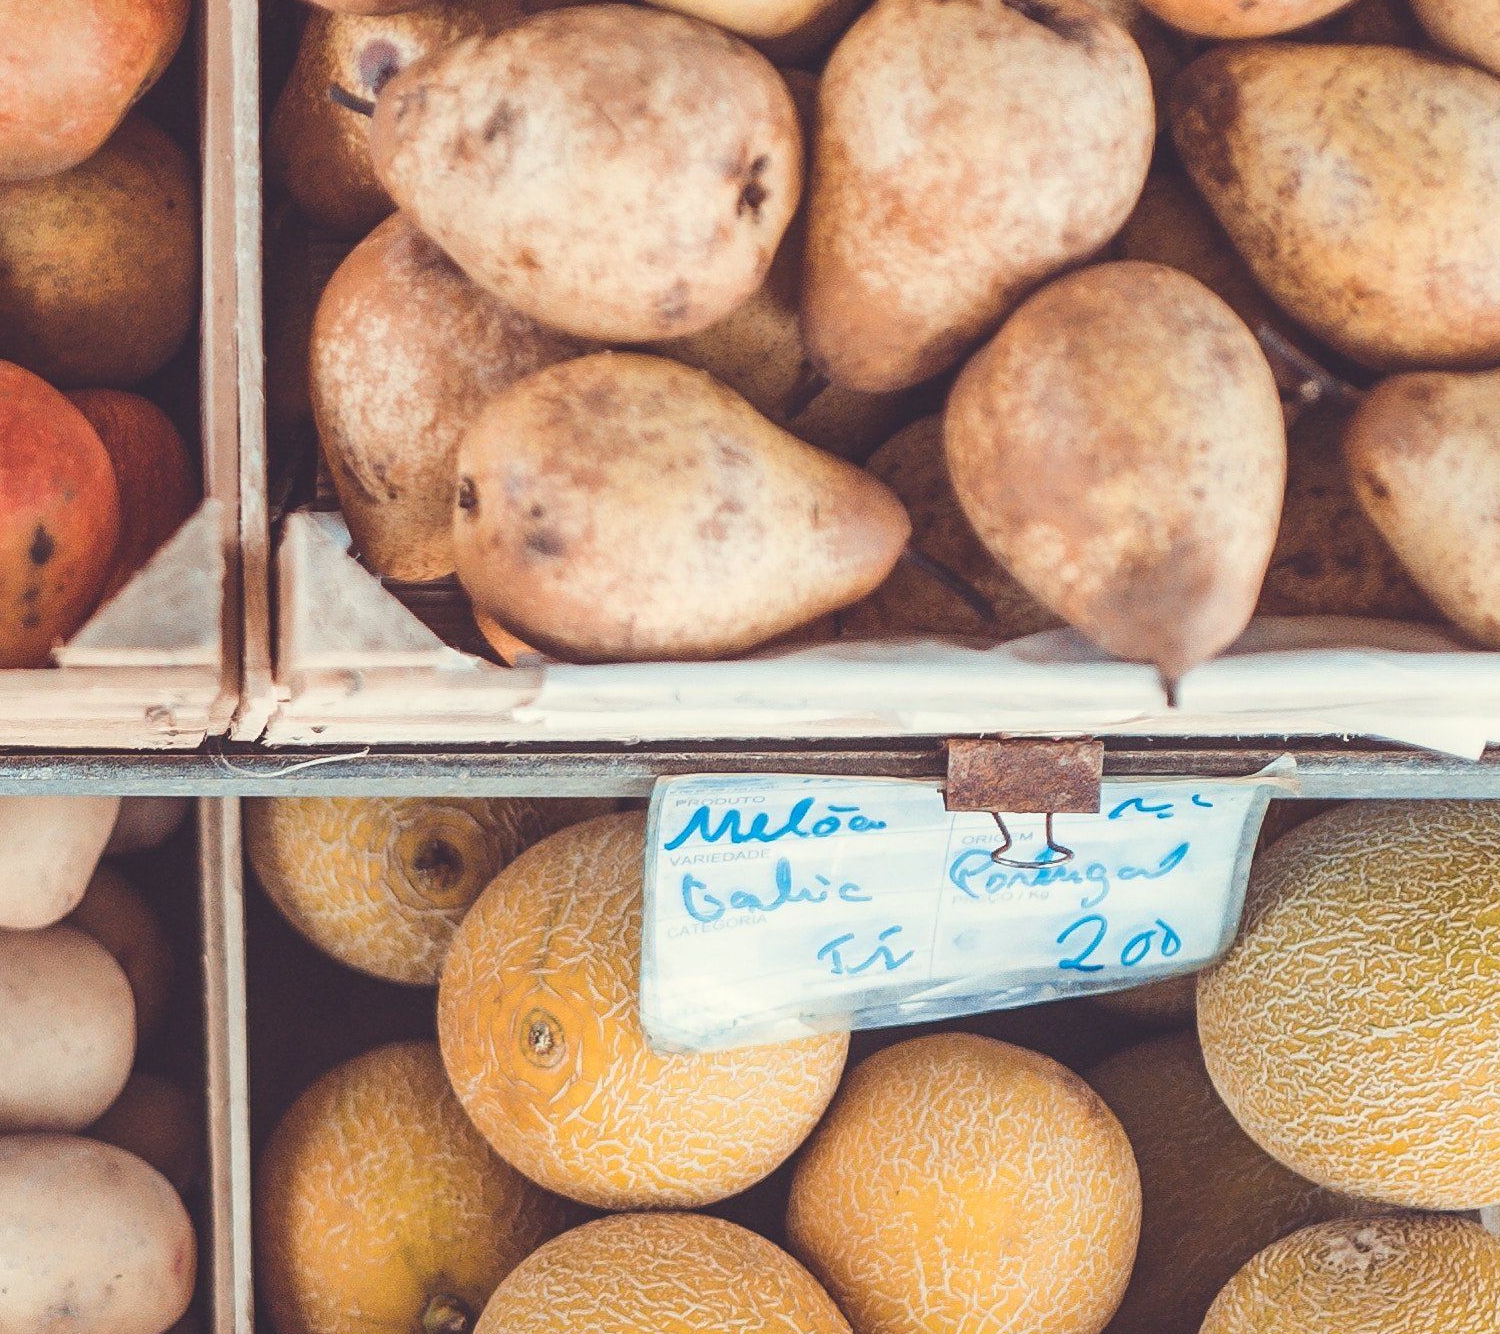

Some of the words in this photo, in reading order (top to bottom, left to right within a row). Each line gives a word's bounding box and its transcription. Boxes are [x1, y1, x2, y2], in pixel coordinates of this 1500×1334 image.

[675, 796, 766, 807] PRODUTO
[670, 849, 770, 867] VARIEDADE
[667, 915, 767, 939] CATEGORIA
